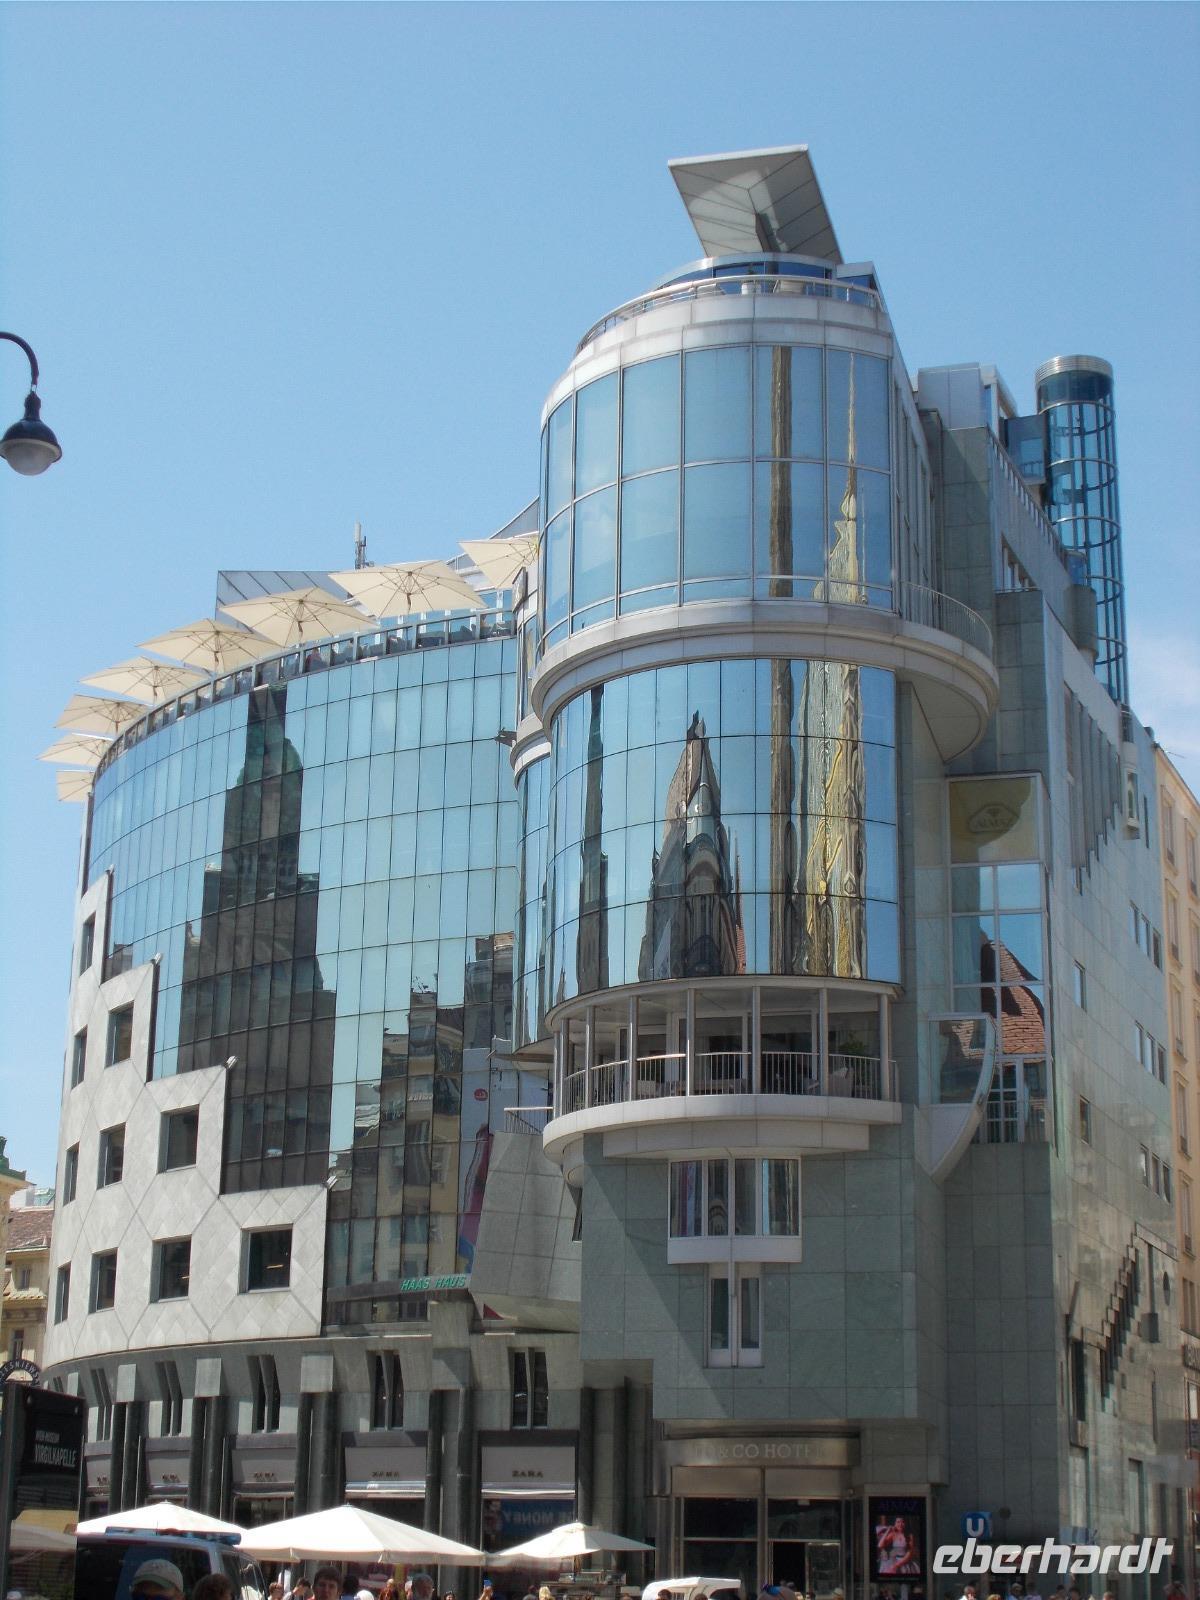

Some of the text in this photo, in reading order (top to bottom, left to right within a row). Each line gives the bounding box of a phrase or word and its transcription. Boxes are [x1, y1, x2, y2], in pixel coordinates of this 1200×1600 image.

[401, 1275, 466, 1291] HAAS HAUS
[35, 1443, 76, 1468] VIRGILKAPELLE
[732, 1444, 760, 1459] CO
[511, 1469, 544, 1479] ZARA
[966, 1518, 985, 1538] U
